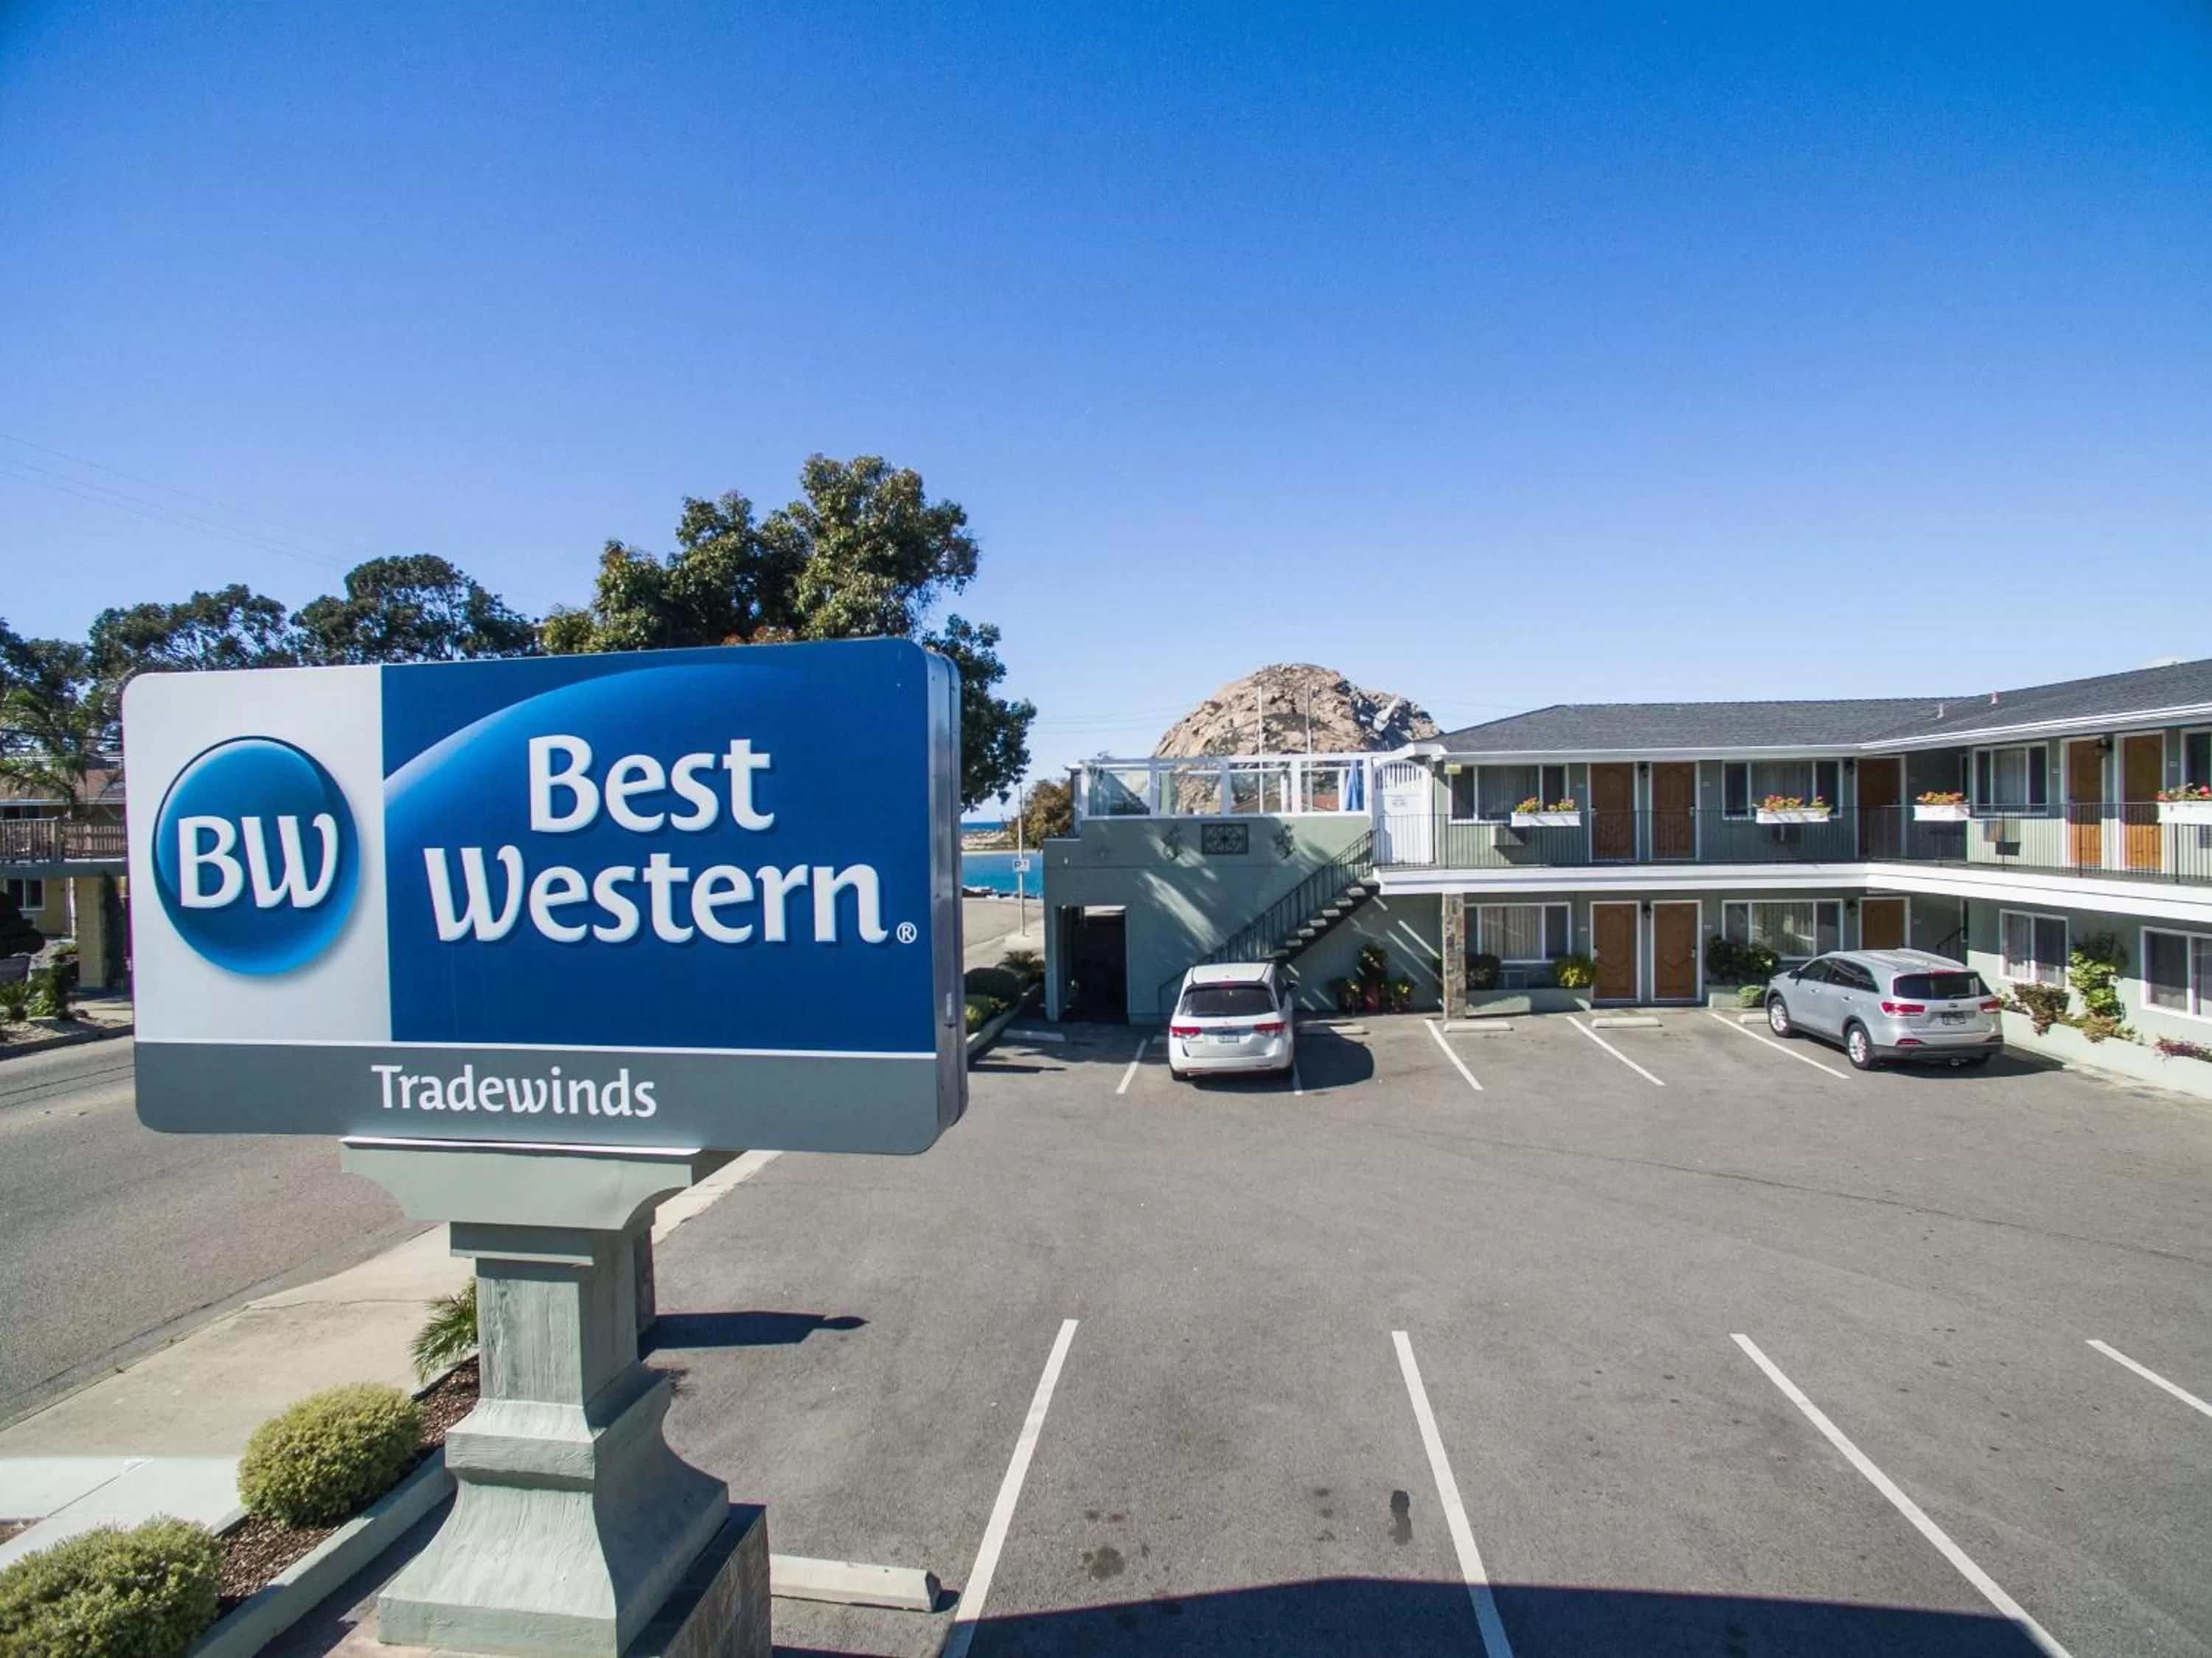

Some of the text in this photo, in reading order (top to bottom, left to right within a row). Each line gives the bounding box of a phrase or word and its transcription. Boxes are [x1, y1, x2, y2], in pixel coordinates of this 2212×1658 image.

[529, 734, 775, 833] Best
[177, 812, 340, 909] BW
[423, 844, 889, 944] Western
[371, 1064, 658, 1117] Tradewinds
